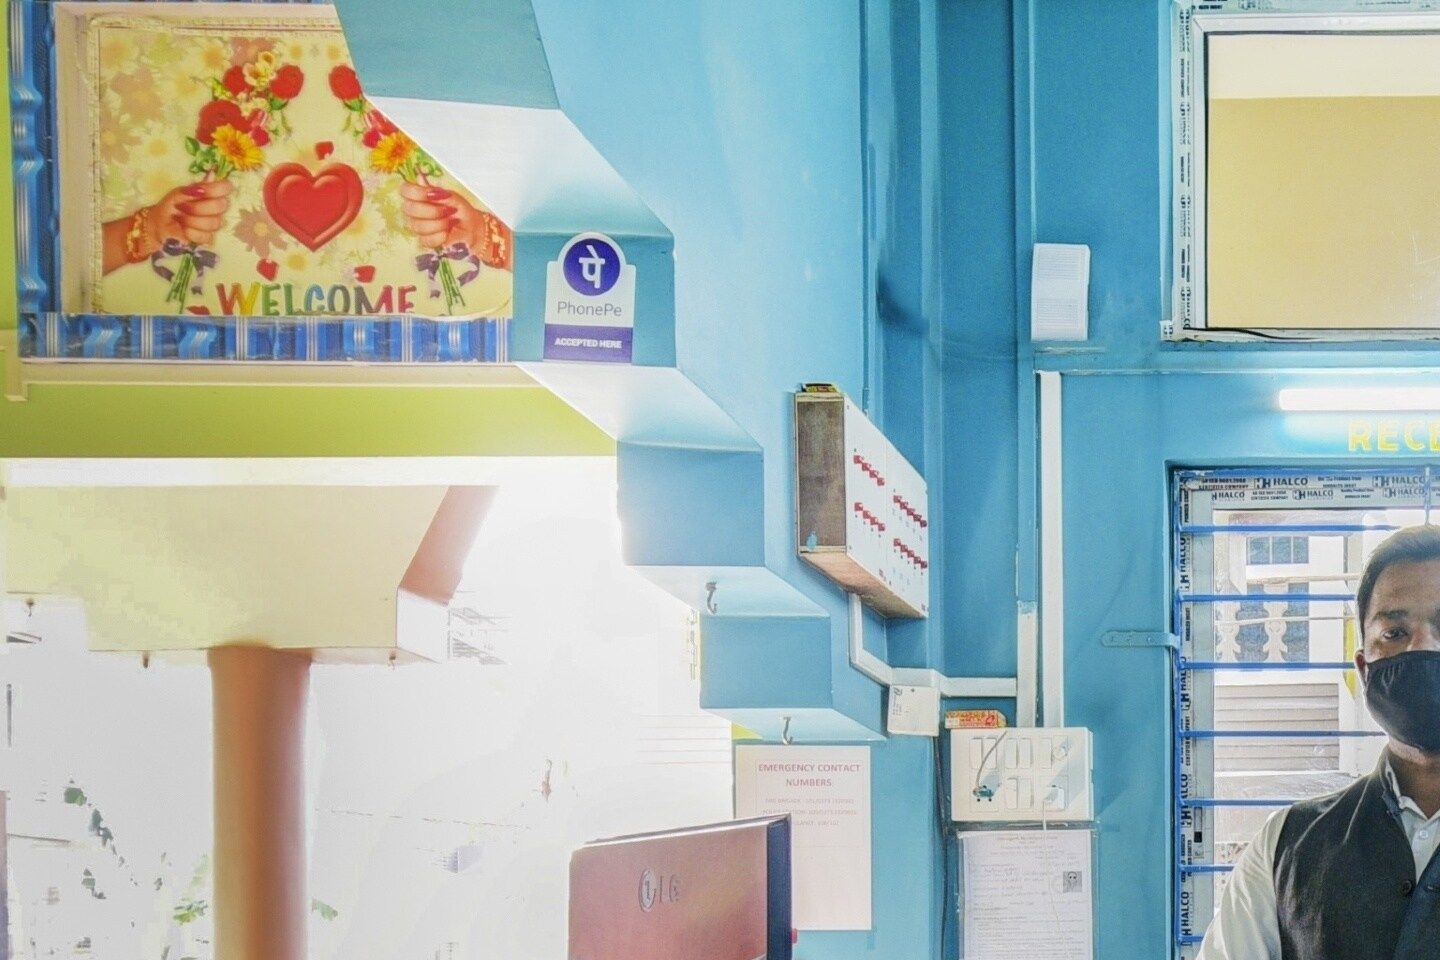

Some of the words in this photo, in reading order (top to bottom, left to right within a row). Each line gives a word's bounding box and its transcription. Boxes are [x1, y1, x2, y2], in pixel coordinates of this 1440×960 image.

[216, 281, 417, 315] WELCOME
[557, 301, 622, 317] PhonePe
[554, 338, 598, 348] ACCEPTED
[599, 340, 622, 348] HERE
[1273, 477, 1308, 486] HALCO
[758, 764, 814, 772] EMERGENCY
[818, 764, 860, 772] CONTACT
[786, 779, 832, 787] NUMBERS
[1181, 892, 1189, 926] HALCO
